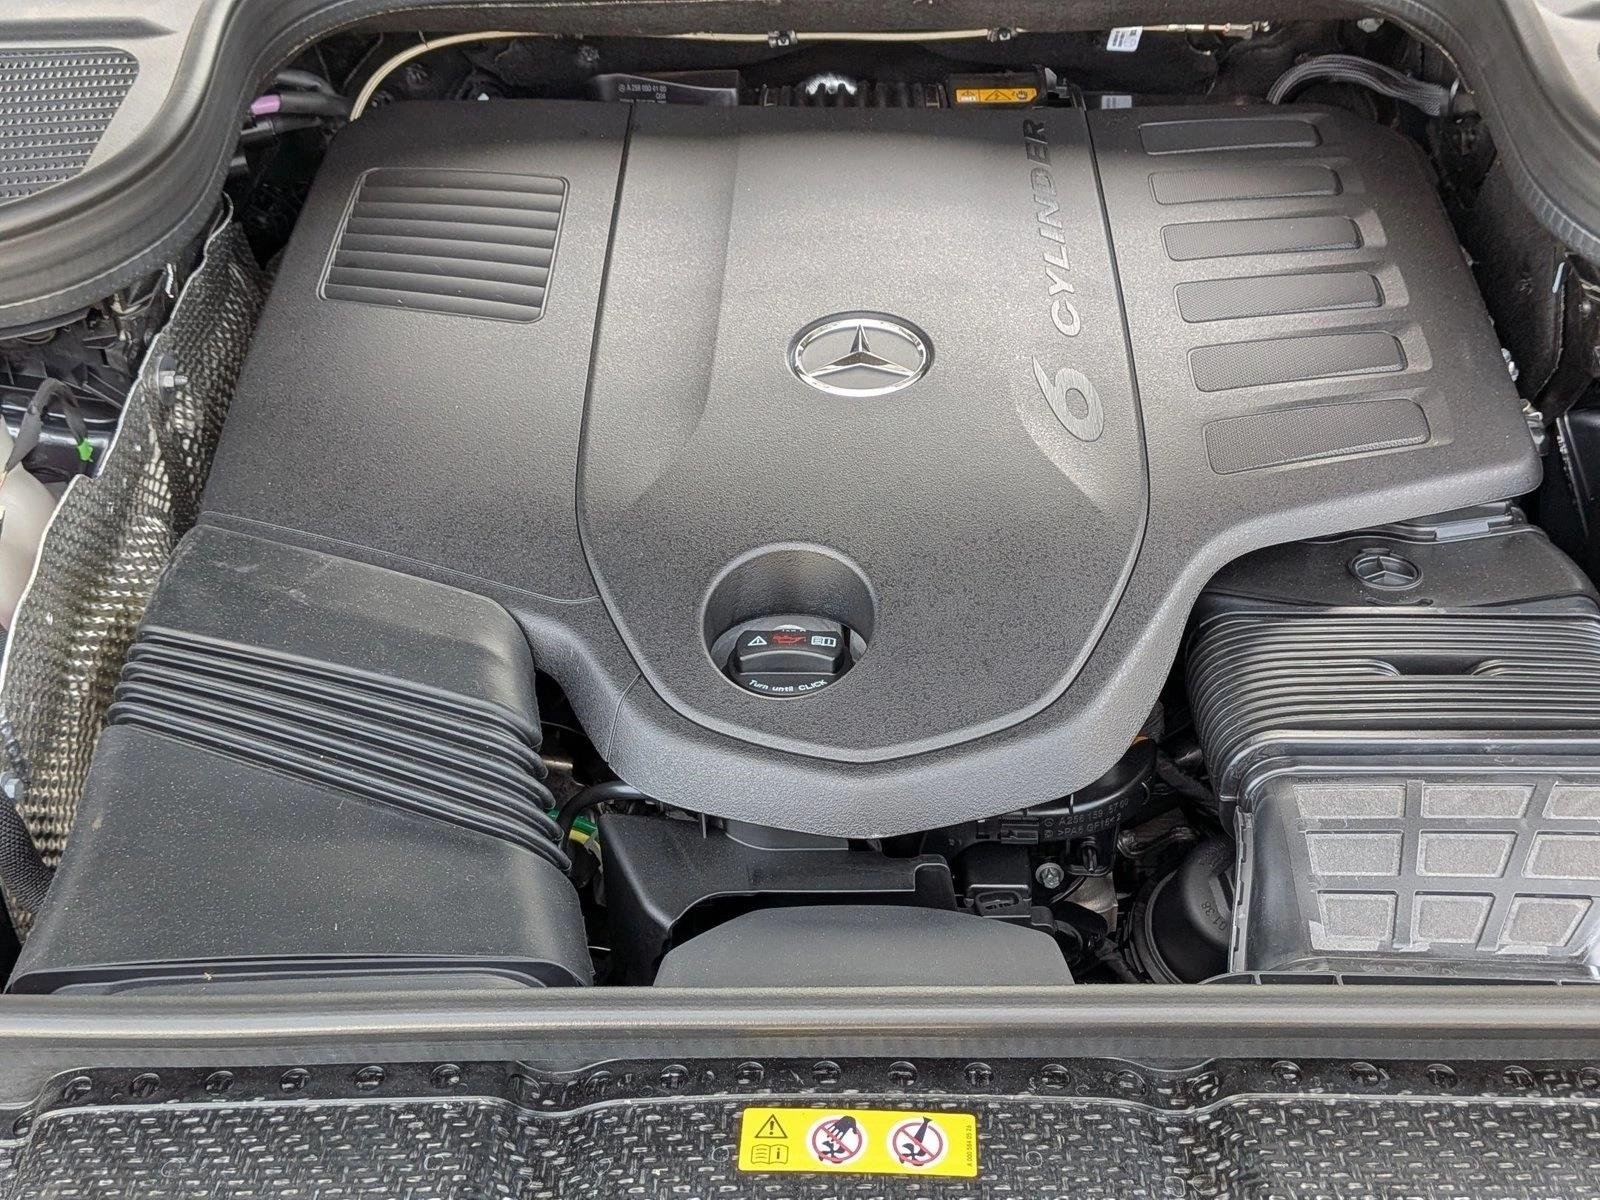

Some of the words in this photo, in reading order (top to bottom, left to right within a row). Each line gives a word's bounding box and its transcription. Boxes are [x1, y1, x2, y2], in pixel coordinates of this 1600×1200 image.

[1022, 118, 1081, 337] CYLINDER
[1032, 355, 1105, 442] 6
[748, 679, 769, 690] Turn
[798, 679, 828, 691] CLICK
